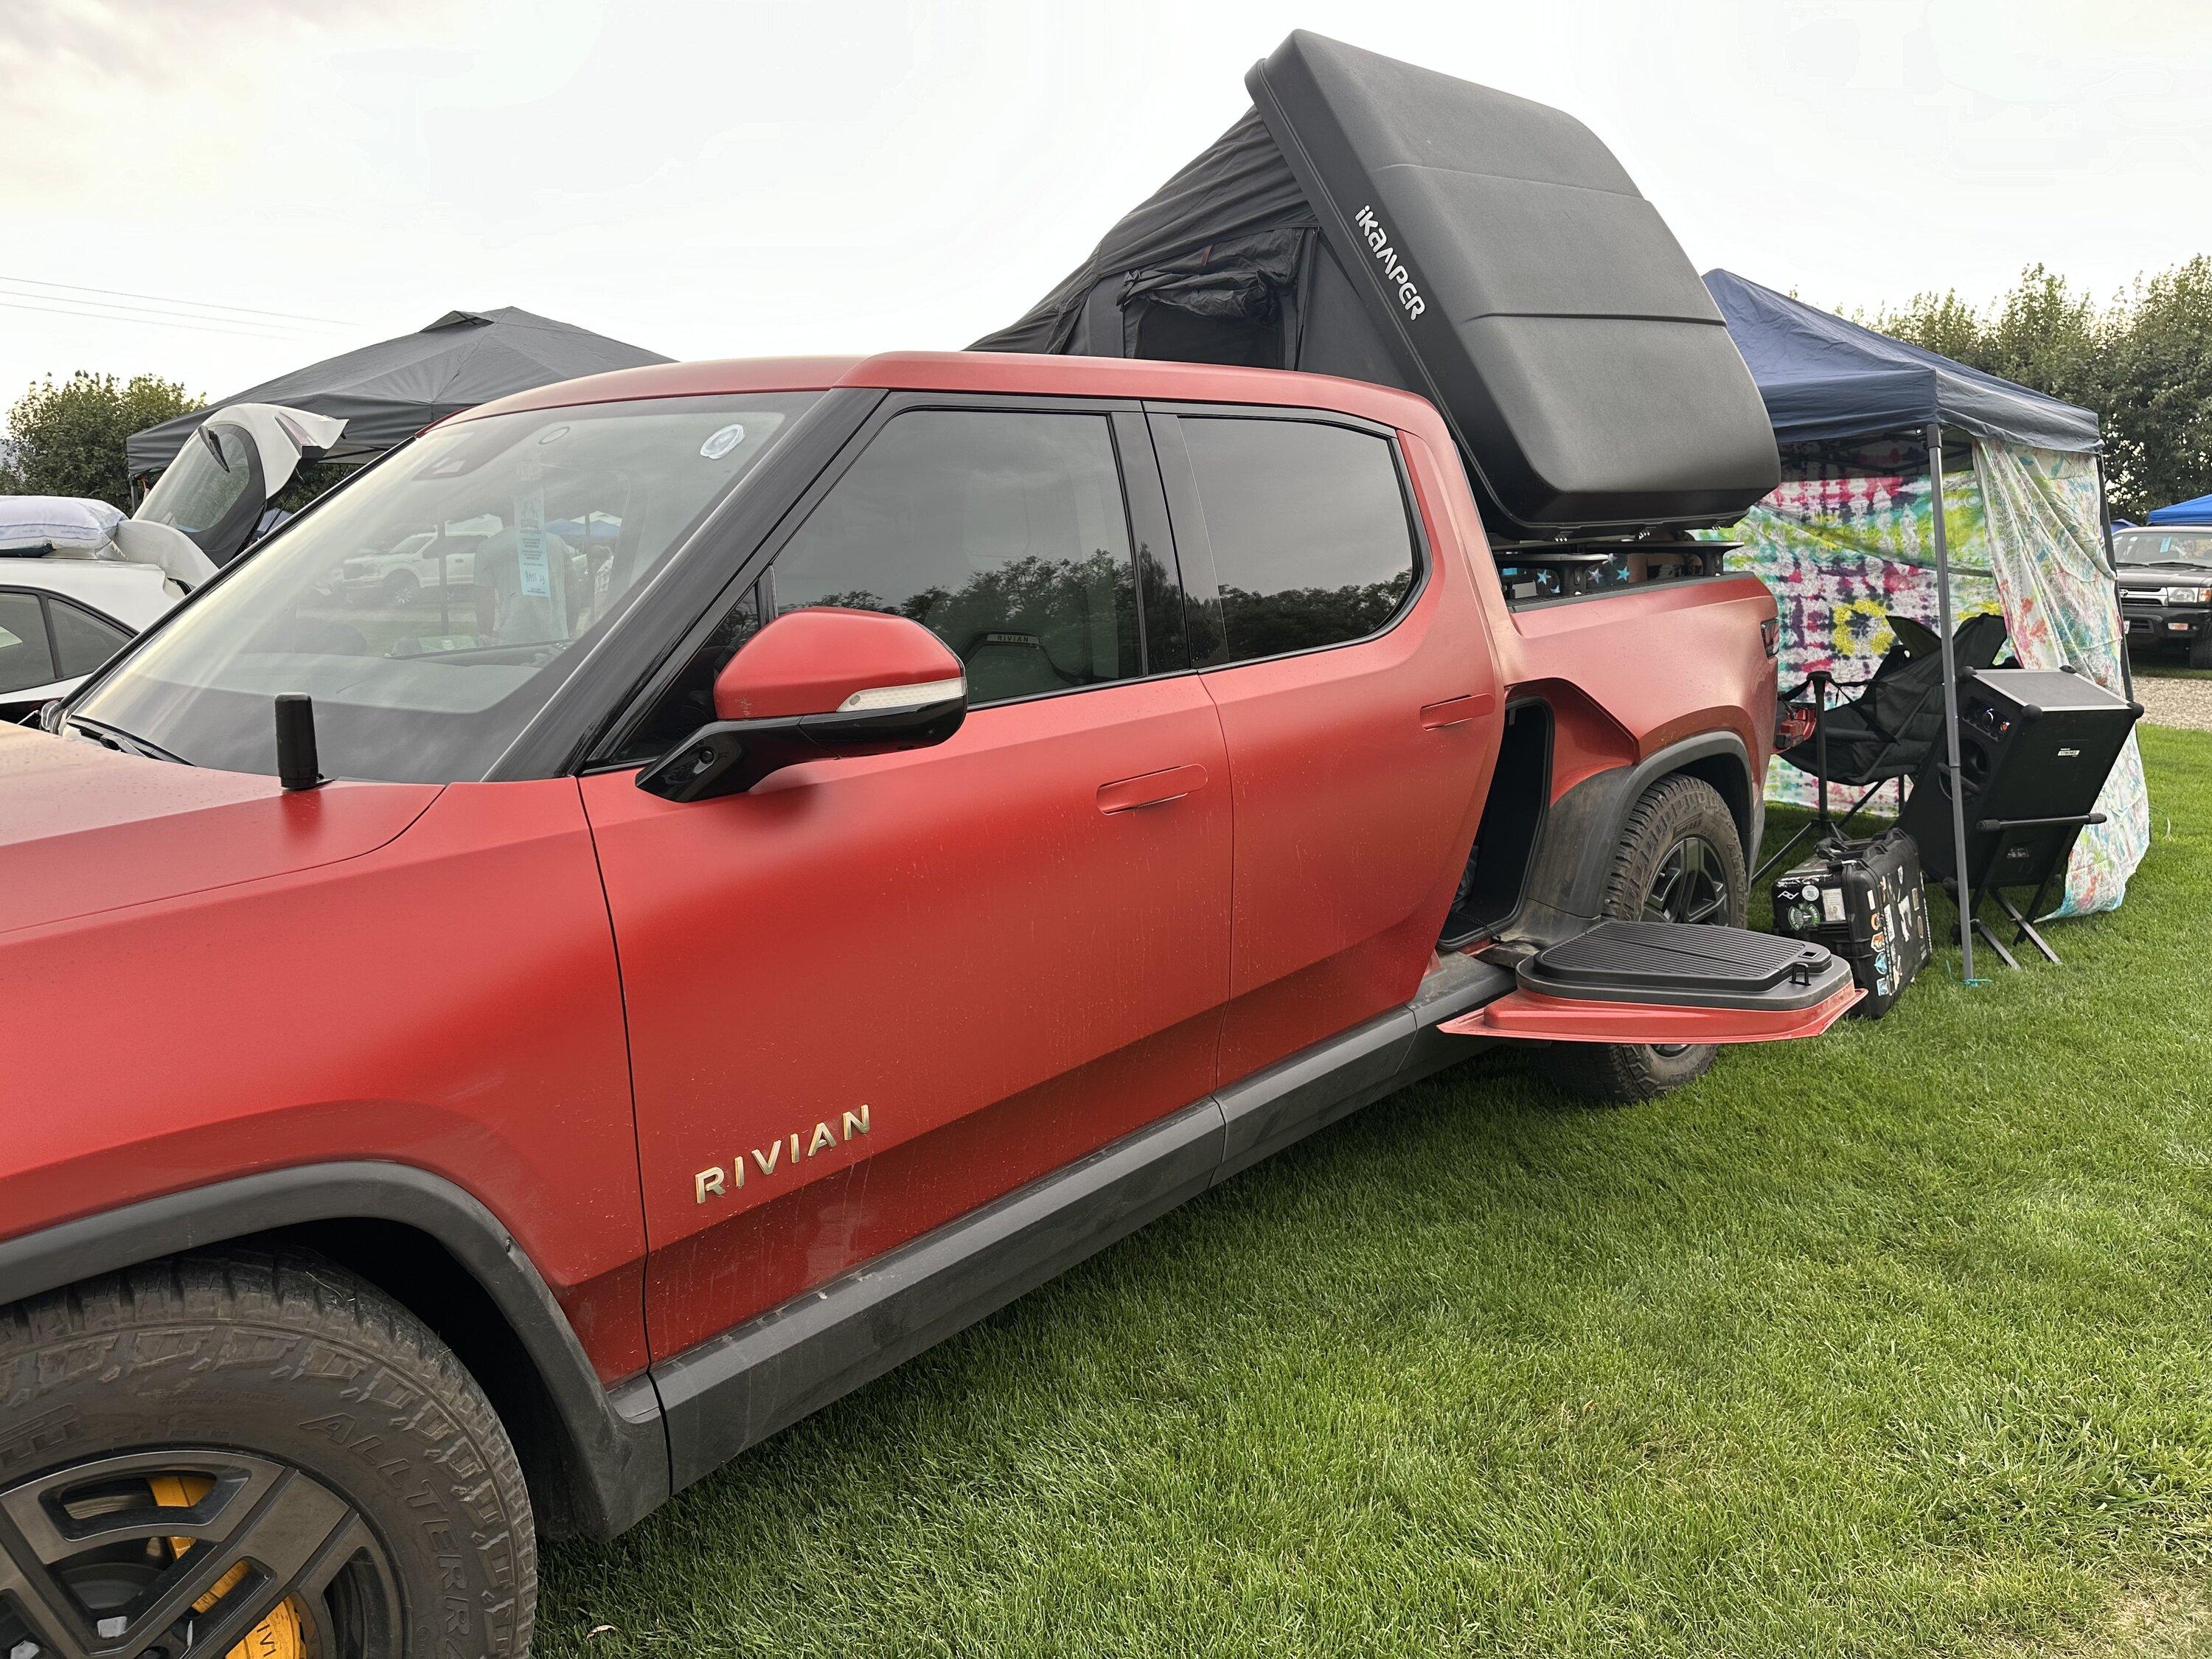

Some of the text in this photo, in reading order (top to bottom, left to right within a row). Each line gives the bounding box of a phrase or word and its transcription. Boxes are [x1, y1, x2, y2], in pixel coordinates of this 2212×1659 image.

[997, 635, 1029, 643] RIVIAN
[695, 1104, 871, 1204] RIVIAN
[298, 1411, 411, 1489] ALL
